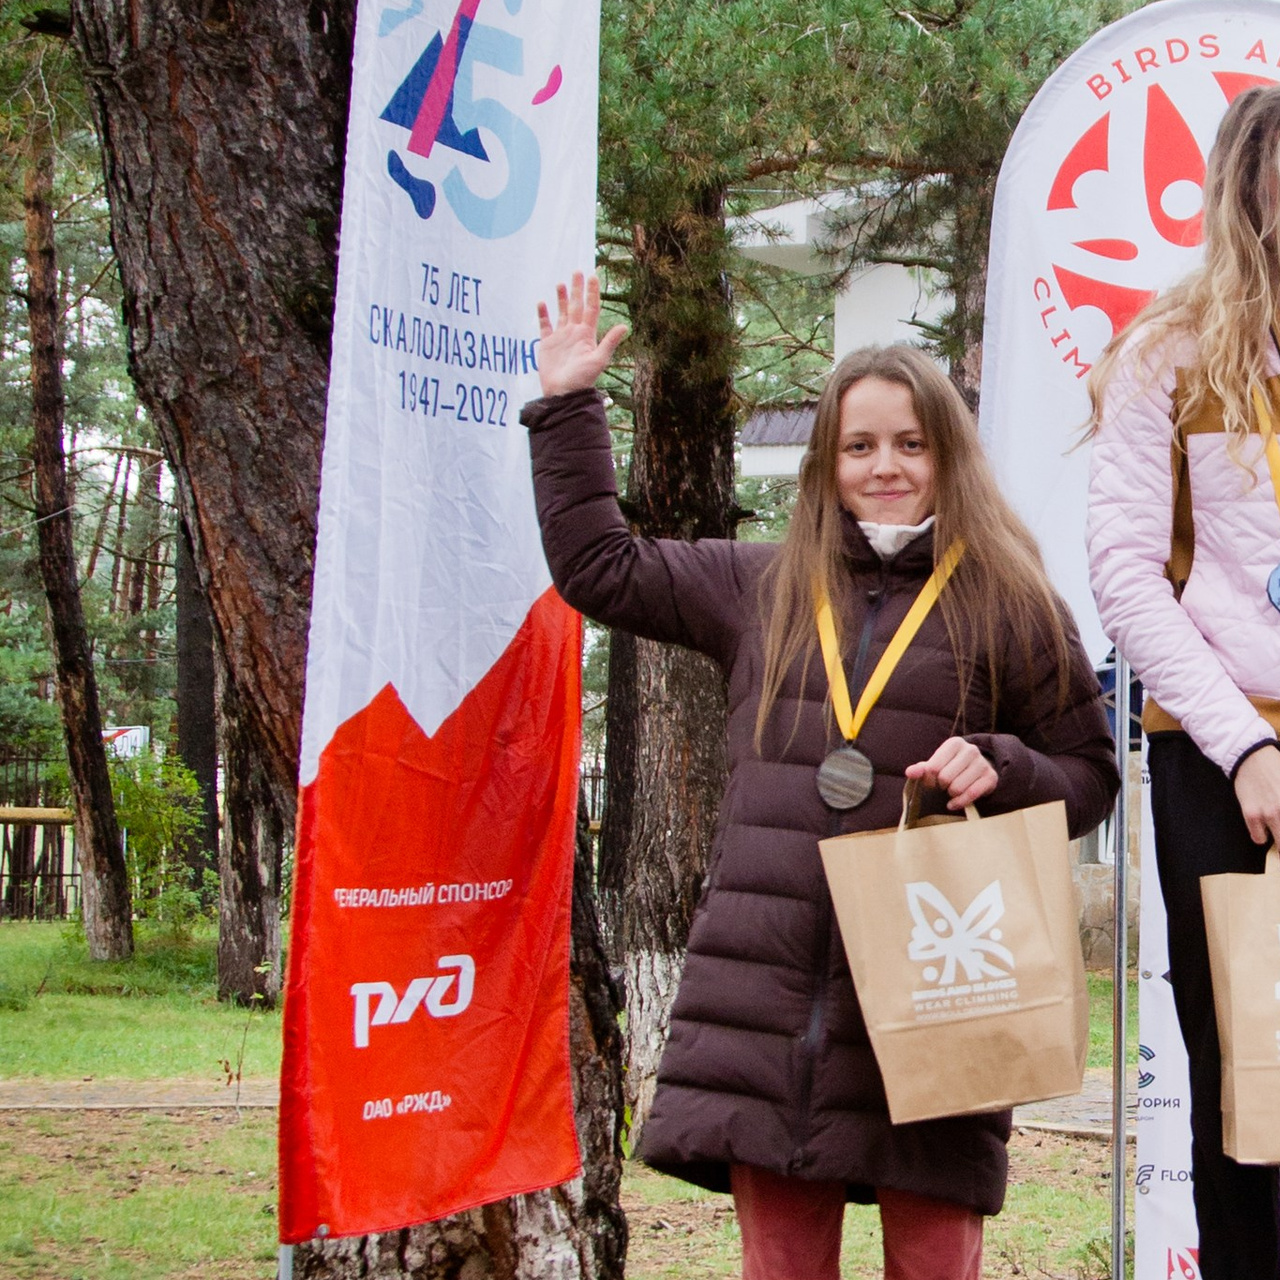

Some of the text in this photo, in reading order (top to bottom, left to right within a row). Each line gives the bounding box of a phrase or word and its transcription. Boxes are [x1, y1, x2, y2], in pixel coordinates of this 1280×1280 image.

[1086, 34, 1221, 101] BIRDS
[421, 263, 482, 316] 75 ЛЕТ
[1033, 276, 1092, 379] CLIM
[334, 882, 434, 908] ГЕНЕРАЛЬНЫЙ
[363, 1098, 393, 1120] ОАО
